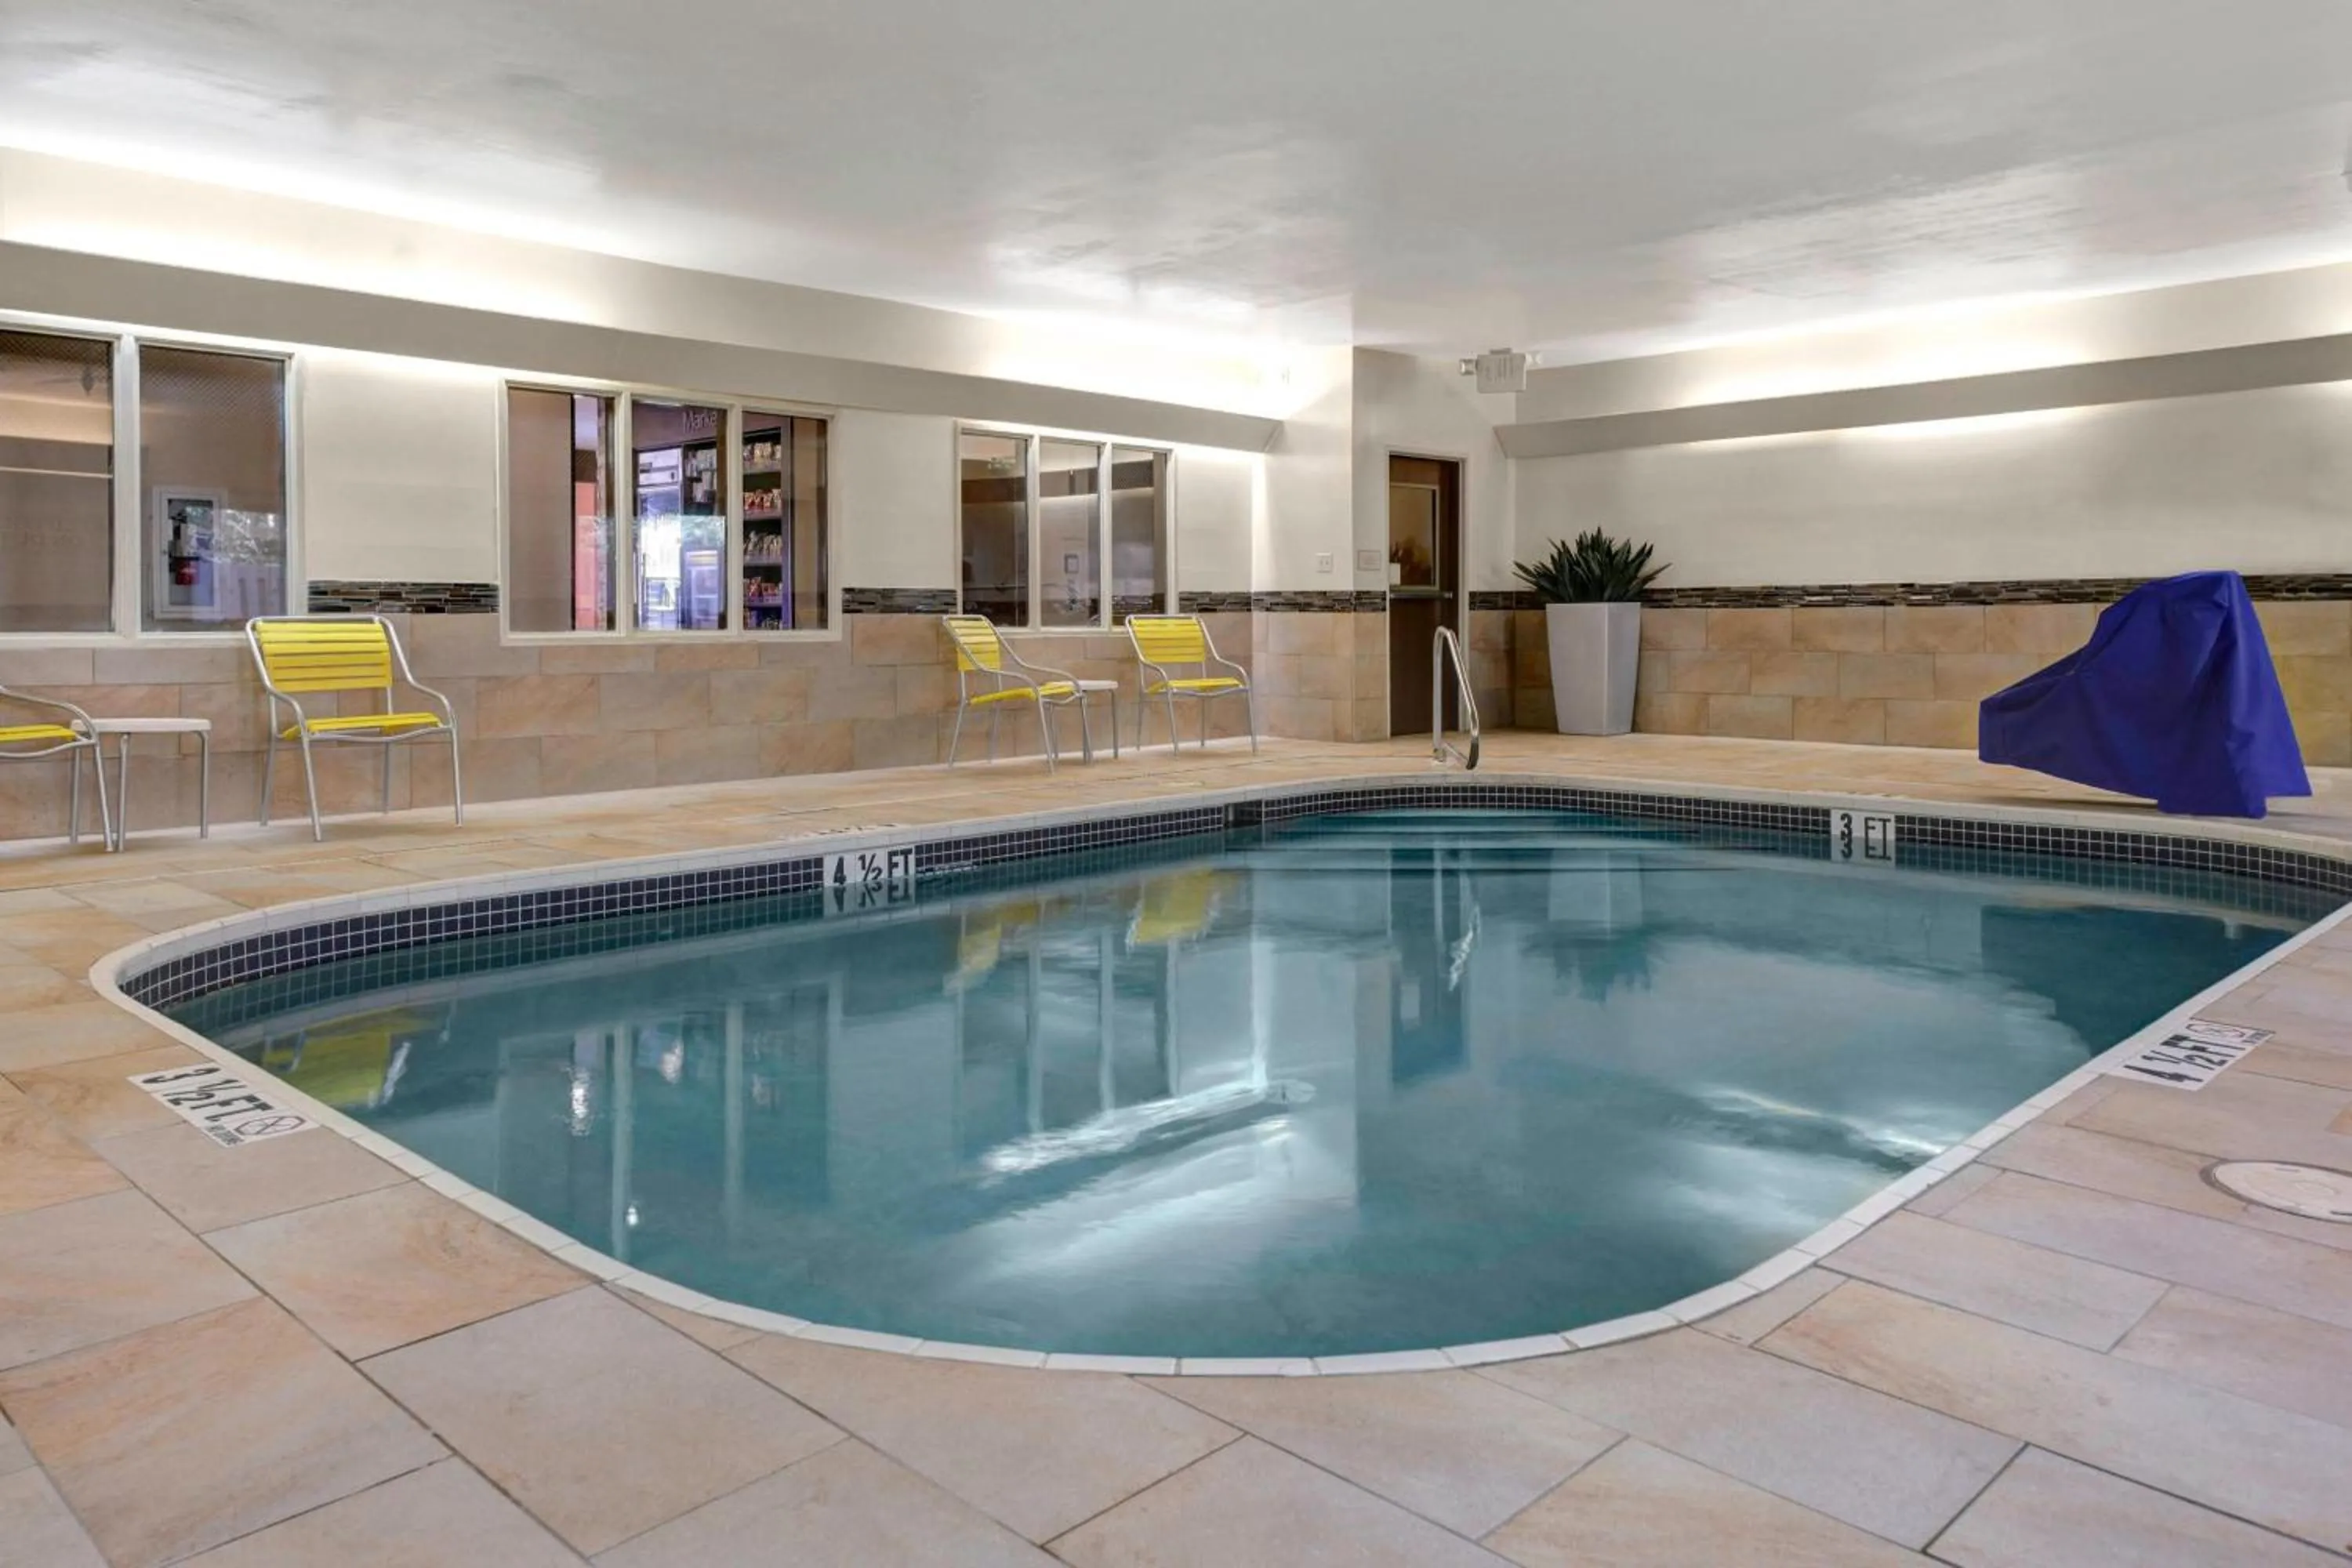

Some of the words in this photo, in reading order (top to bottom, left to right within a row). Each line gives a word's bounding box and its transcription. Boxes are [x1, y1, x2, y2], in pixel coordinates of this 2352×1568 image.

[682, 410, 718, 434] Marke
[1840, 812, 1853, 837] 3
[1864, 816, 1891, 838] FT
[887, 848, 913, 879] FT
[2160, 1034, 2246, 1058] FT
[190, 1094, 274, 1123] FT
